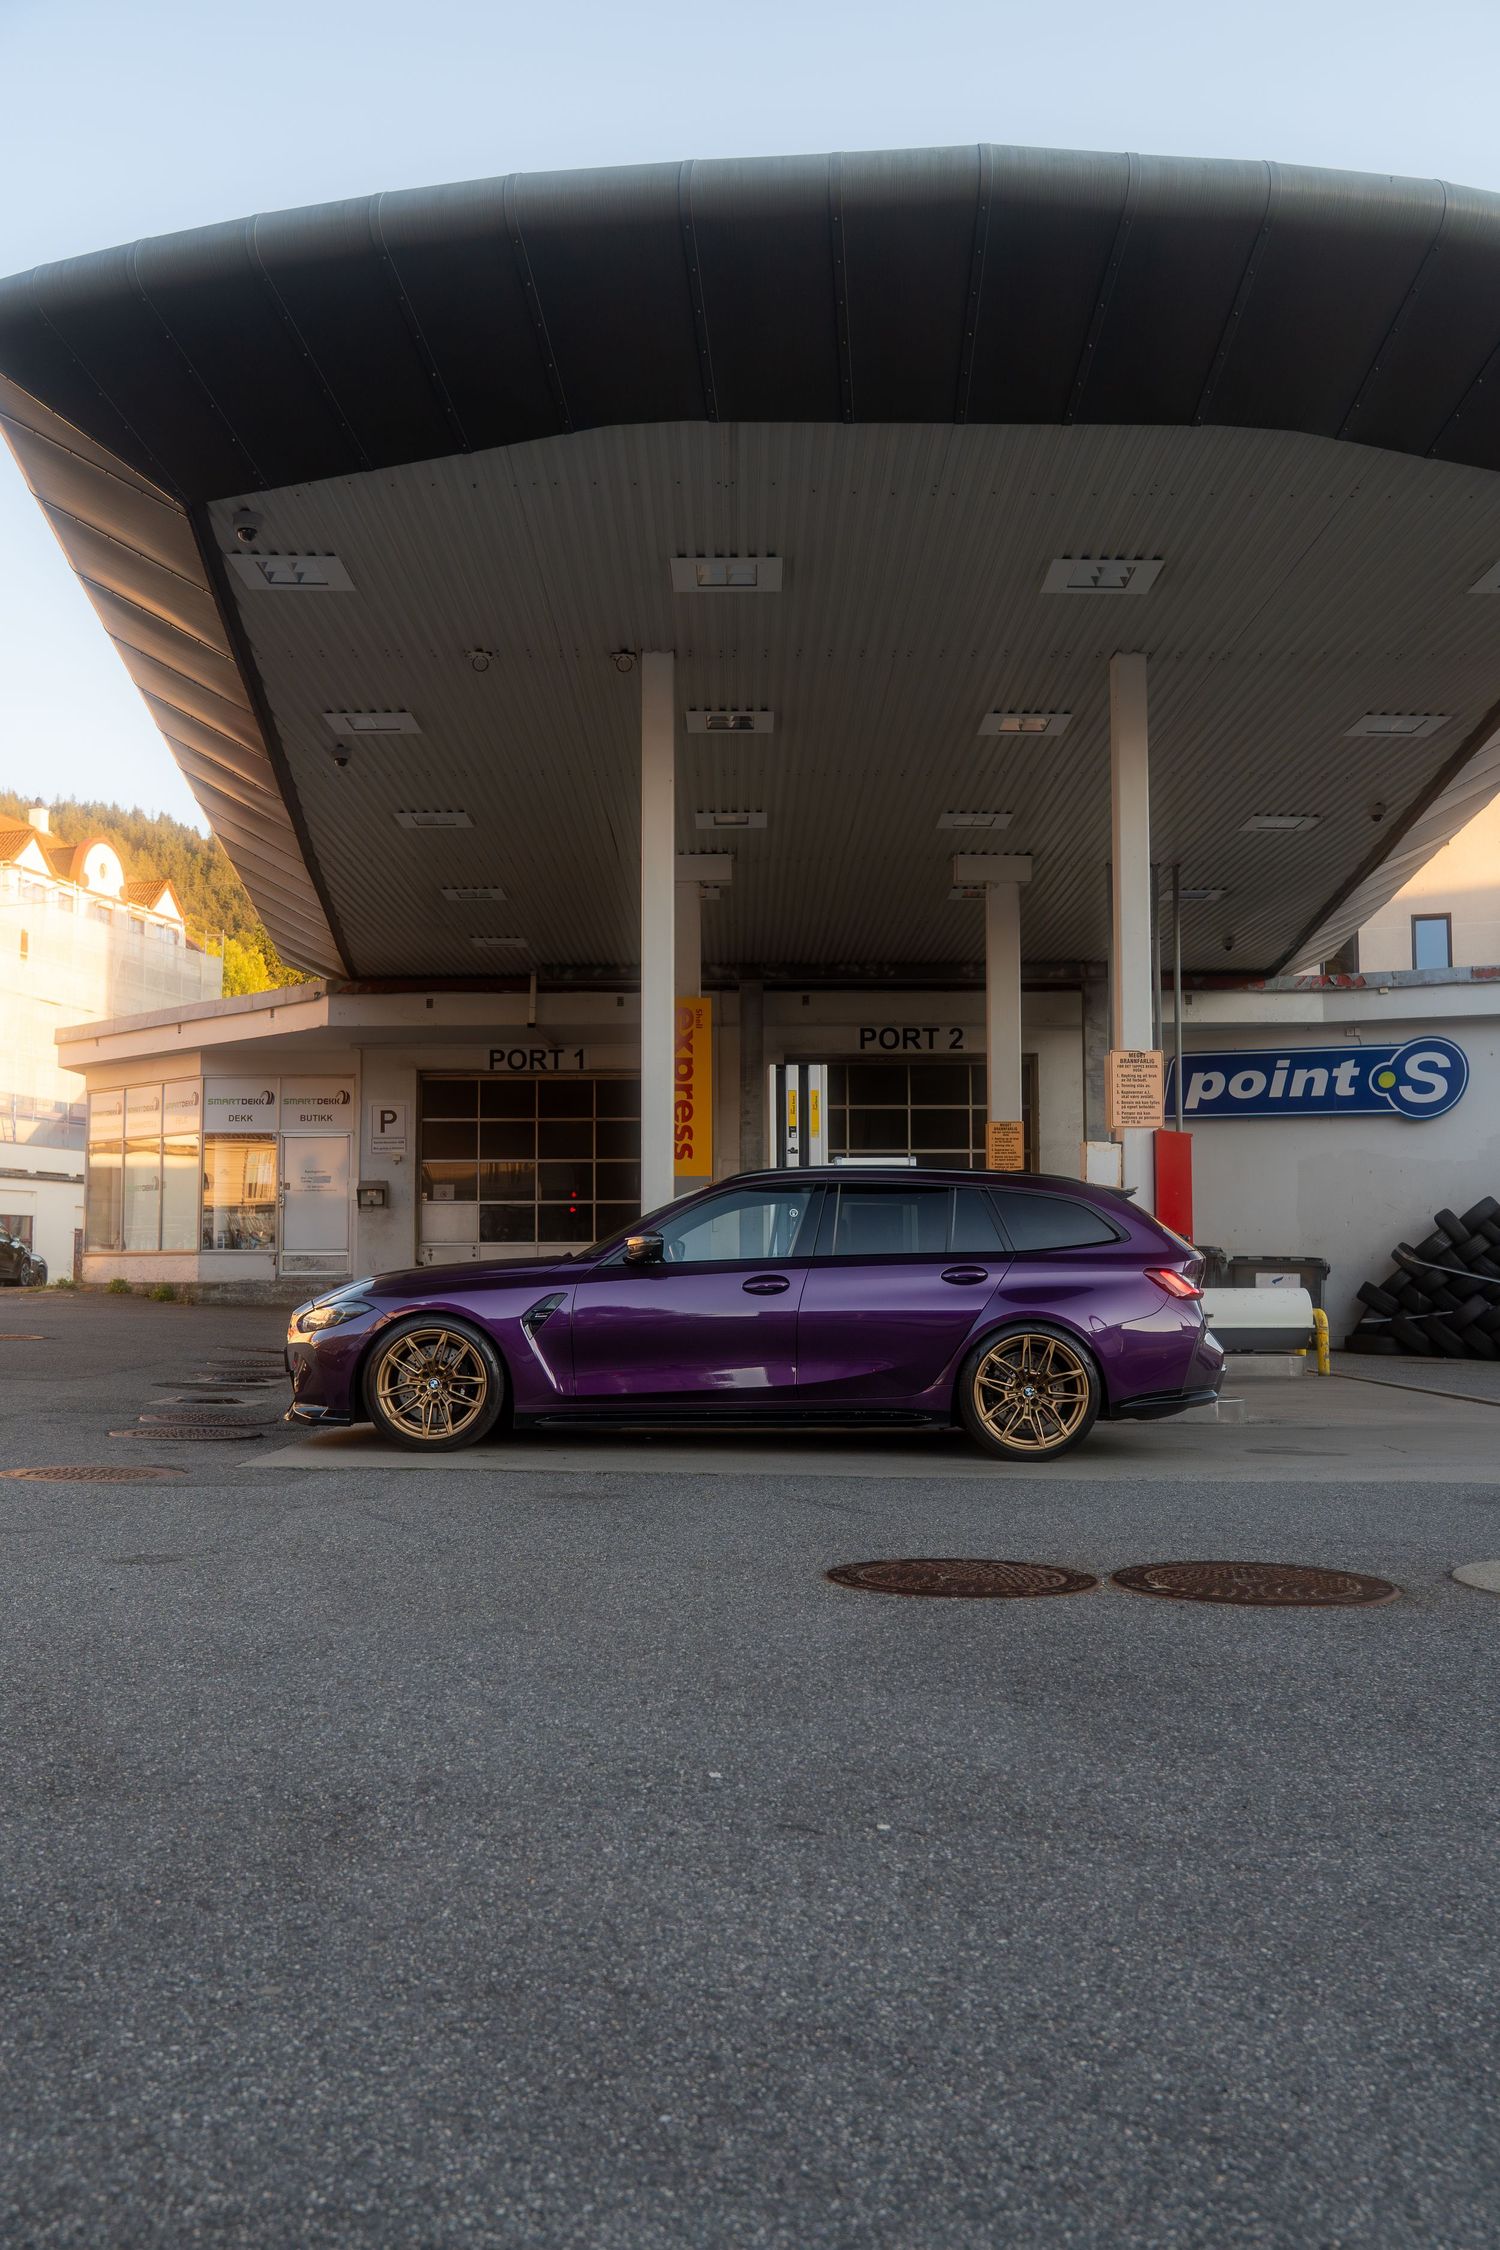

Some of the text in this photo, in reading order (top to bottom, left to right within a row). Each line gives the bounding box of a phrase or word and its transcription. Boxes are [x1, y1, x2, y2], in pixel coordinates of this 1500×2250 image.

[695, 1008, 704, 1029] Shell
[860, 1027, 964, 1050] PORT 2
[489, 1048, 584, 1070] PORT 1
[674, 1006, 694, 1161] express
[1184, 1051, 1452, 1110] point S
[228, 1114, 254, 1122] DEKK
[300, 1114, 333, 1122] BUTIKK
[380, 1110, 398, 1133] P
